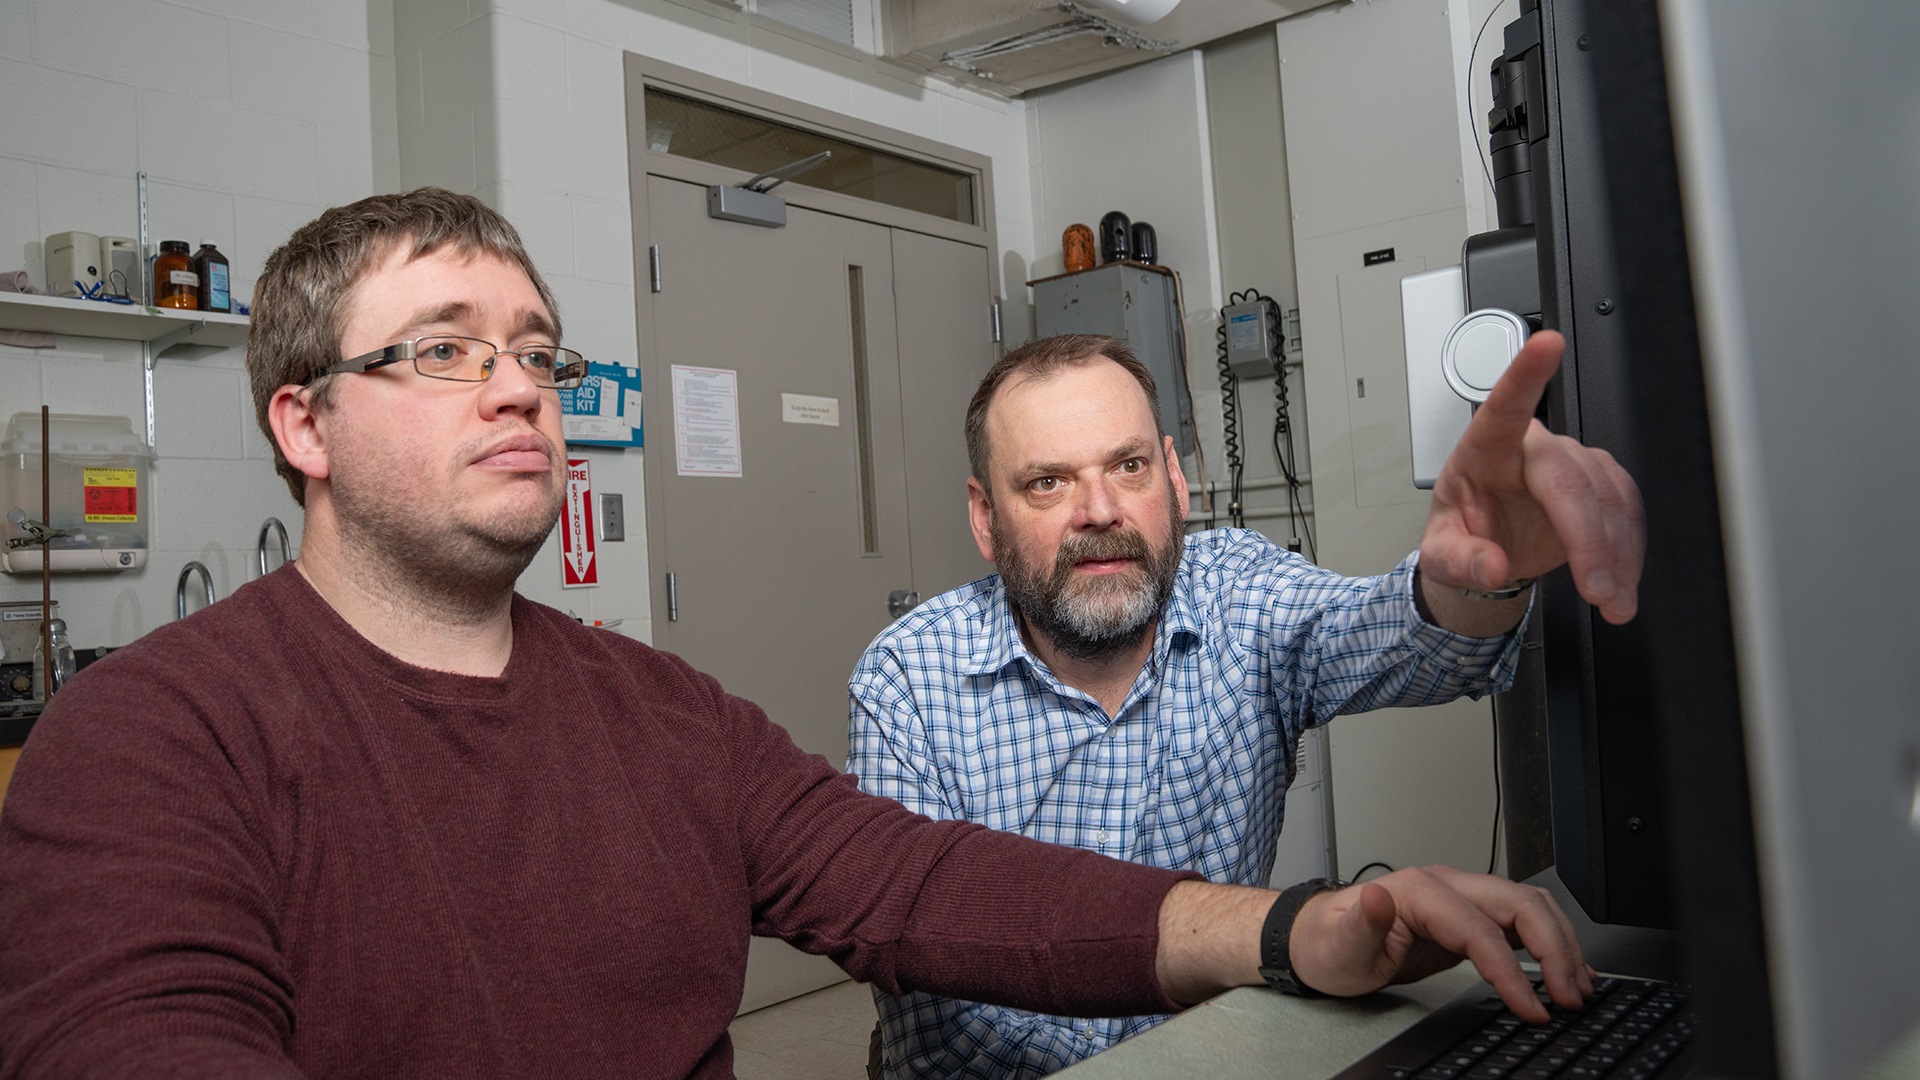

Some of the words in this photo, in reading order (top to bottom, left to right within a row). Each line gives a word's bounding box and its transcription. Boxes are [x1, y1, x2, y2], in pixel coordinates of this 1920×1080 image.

[577, 388, 596, 399] AID
[577, 399, 595, 412] KIT
[568, 470, 587, 480] IRE
[572, 483, 584, 573] EXTINGUISHER
